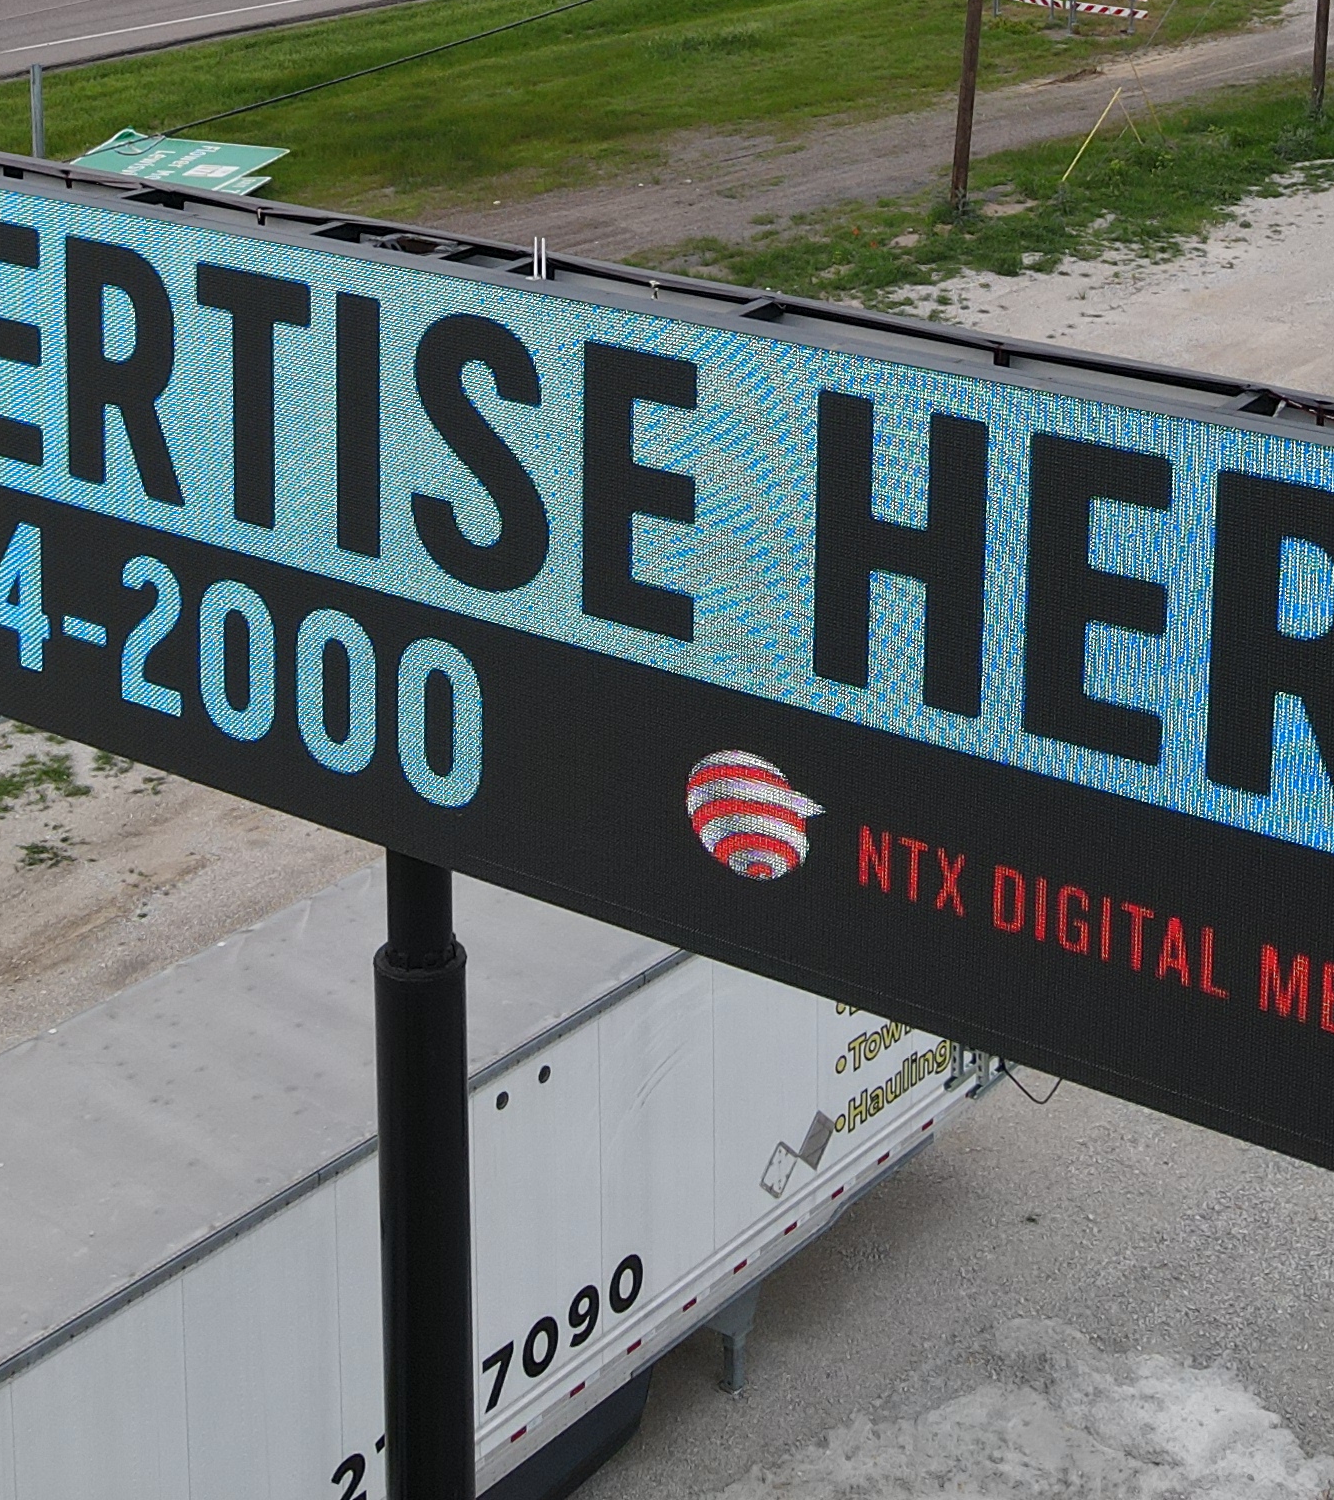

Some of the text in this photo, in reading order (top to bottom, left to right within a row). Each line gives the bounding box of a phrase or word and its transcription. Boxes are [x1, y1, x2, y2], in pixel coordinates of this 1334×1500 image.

[858, 826, 966, 915] NTX
[992, 865, 1227, 998] DIGITAL
[848, 1039, 953, 1133] Hauling
